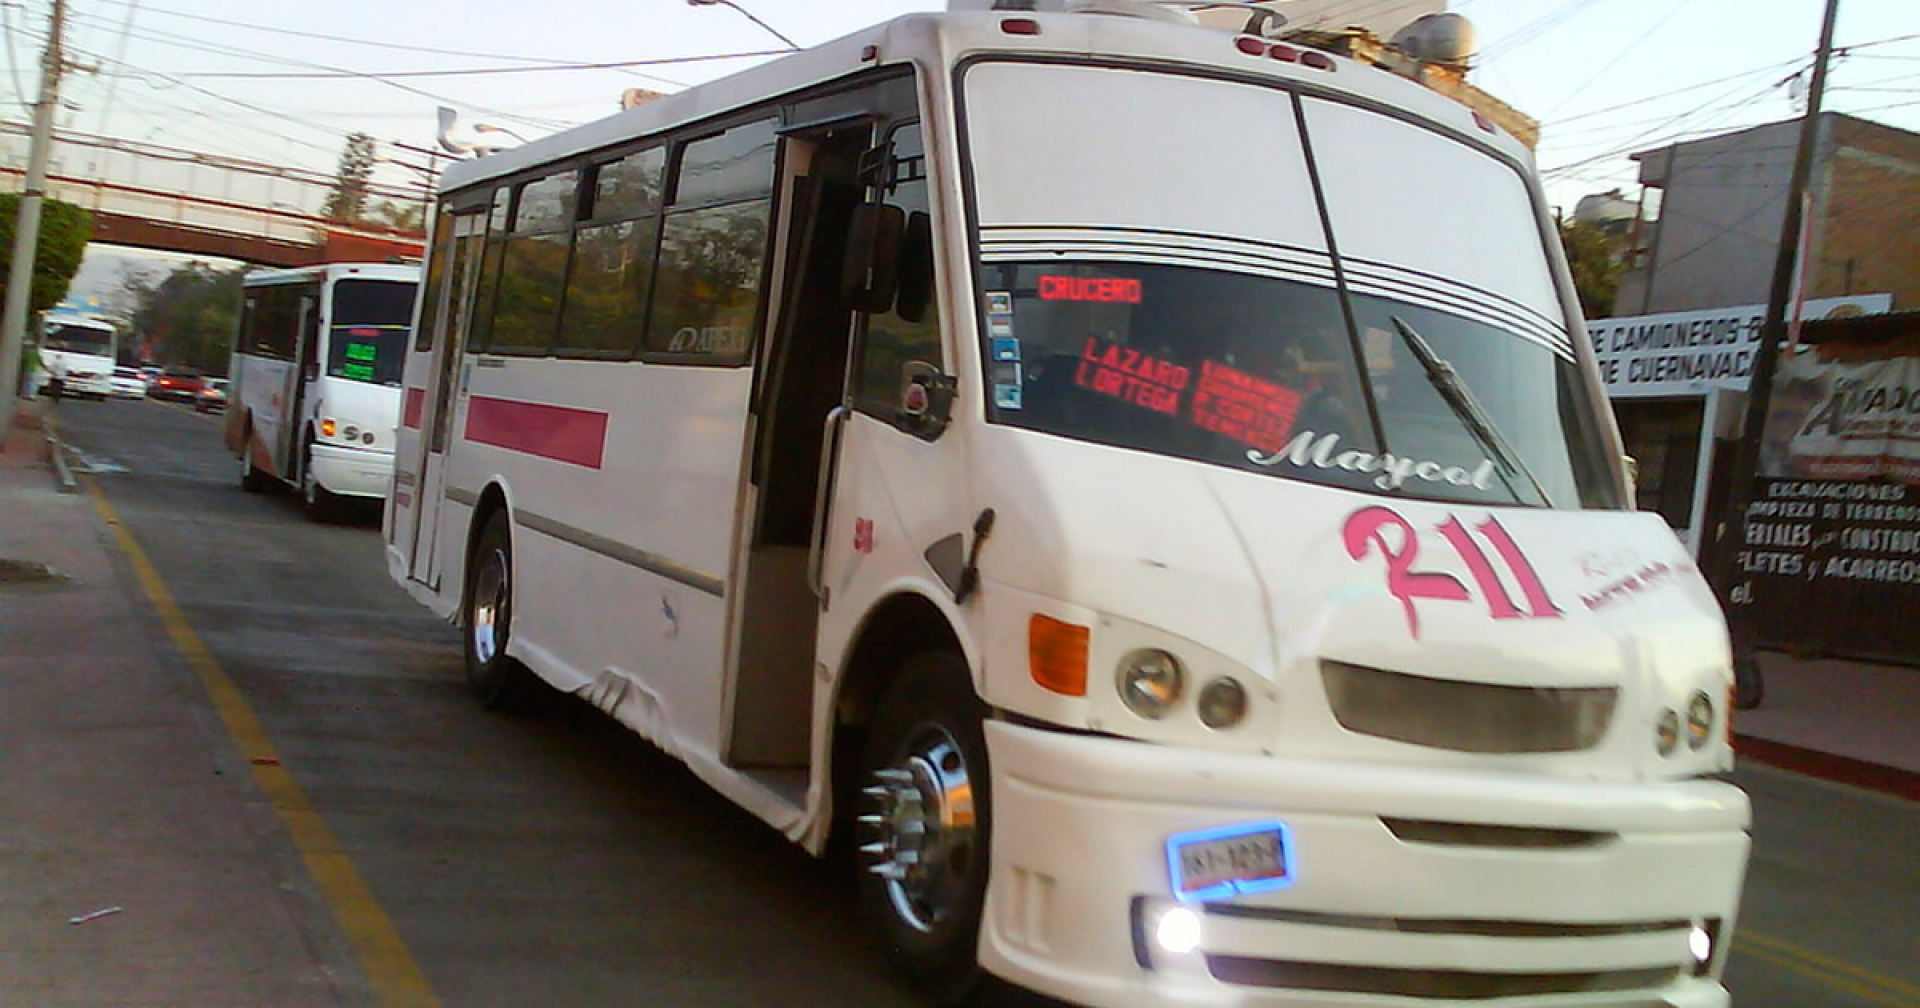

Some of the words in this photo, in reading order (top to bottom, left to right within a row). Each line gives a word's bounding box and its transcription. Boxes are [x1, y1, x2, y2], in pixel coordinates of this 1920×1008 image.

[1037, 275, 1142, 304] CRUCERO
[1083, 336, 1189, 391] LAZARO
[1247, 430, 1494, 491] Maycol
